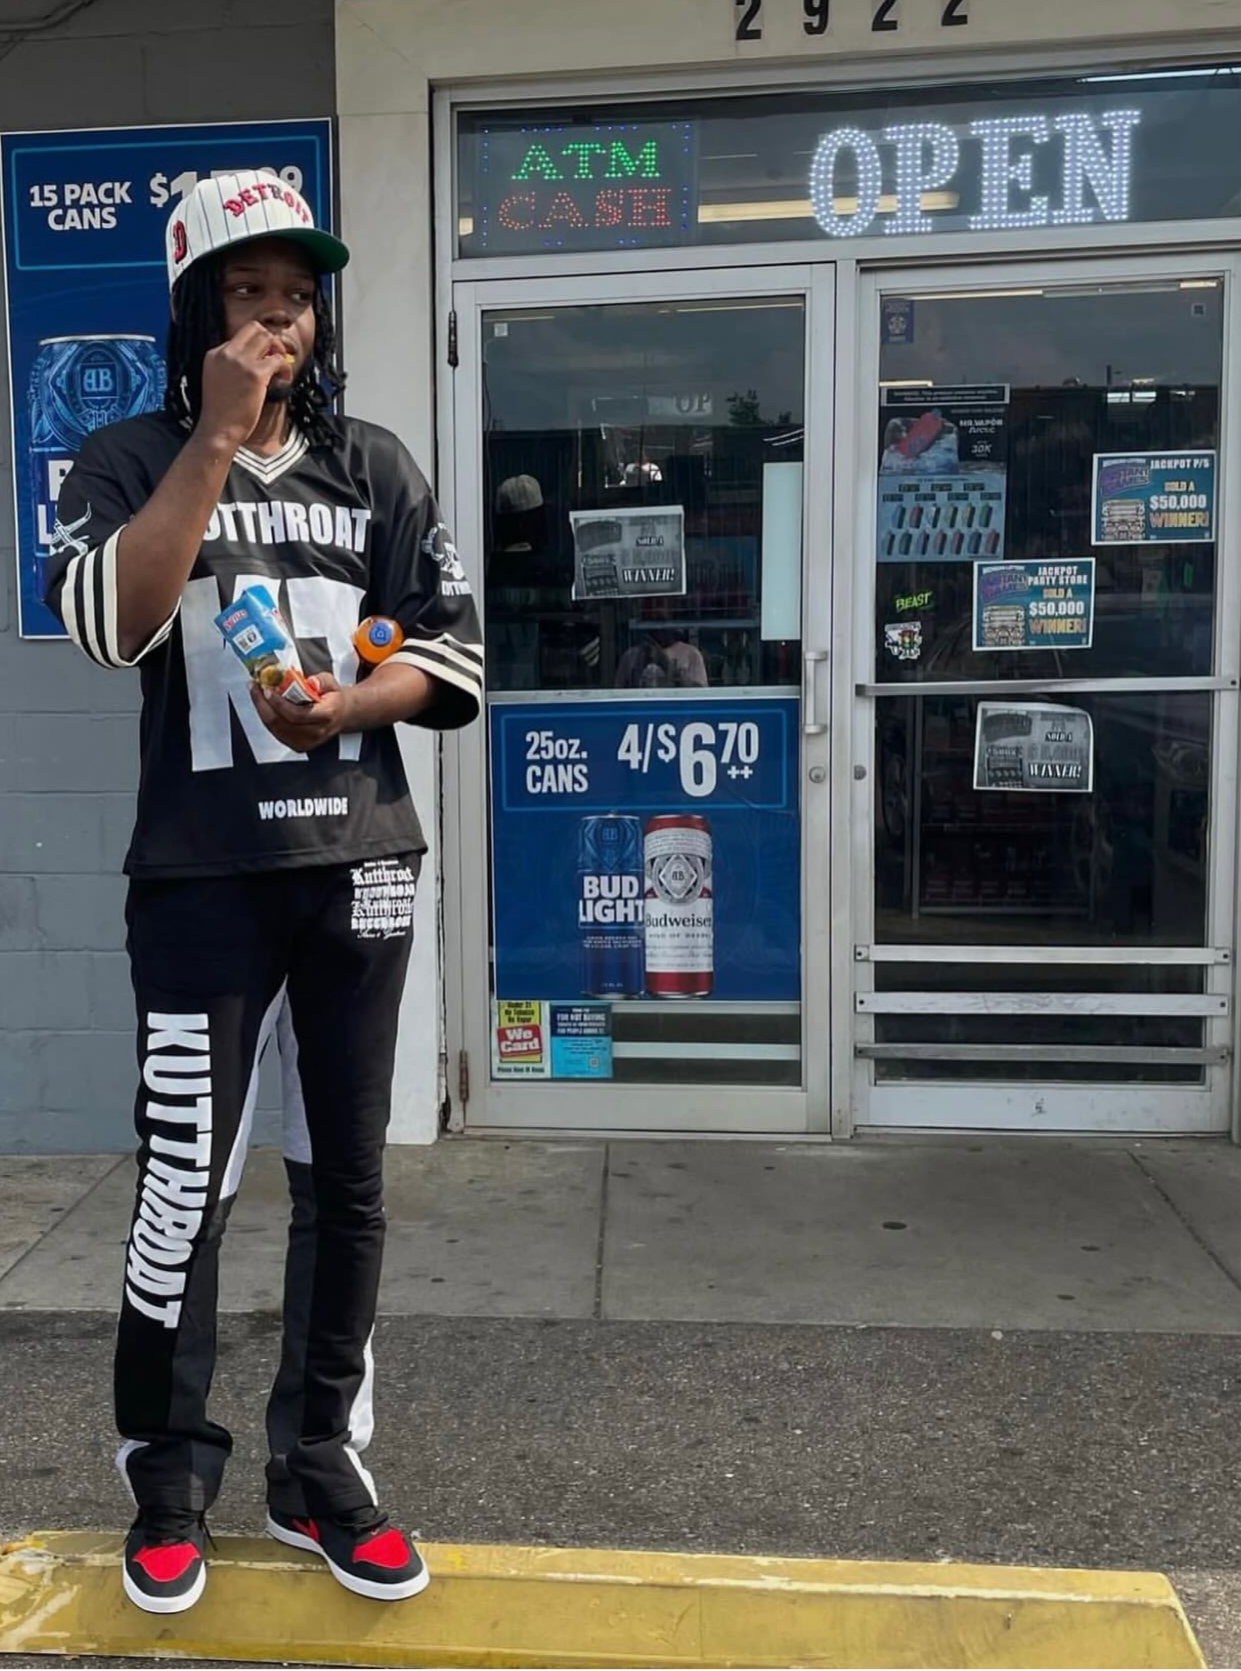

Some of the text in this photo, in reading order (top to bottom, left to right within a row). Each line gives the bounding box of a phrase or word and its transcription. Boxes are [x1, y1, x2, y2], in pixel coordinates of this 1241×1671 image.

[511, 140, 661, 180] ATM
[809, 109, 1142, 237] OPEN
[29, 181, 133, 207] 15 PACK
[223, 183, 309, 218] DETROIT
[47, 209, 118, 231] CANS
[499, 188, 671, 230] CASH
[1150, 458, 1192, 470] JACKPOT
[1149, 494, 1207, 511] $50,000
[622, 567, 676, 584] WINNER!
[1028, 575, 1057, 586] PARTY
[1038, 566, 1079, 576] JACKPOT
[896, 591, 933, 613] BEAST
[1029, 601, 1085, 617] $50,000
[525, 731, 588, 760] 25oz.
[526, 764, 588, 794] CANS
[1028, 762, 1082, 779] WINNER!
[259, 798, 349, 820] WORLDWIDE
[583, 876, 639, 898] BUD
[579, 899, 645, 923] LIGHT
[500, 1038, 540, 1052] Card
[505, 1028, 533, 1040] We
[122, 1011, 213, 1331] KUTTHROAT
